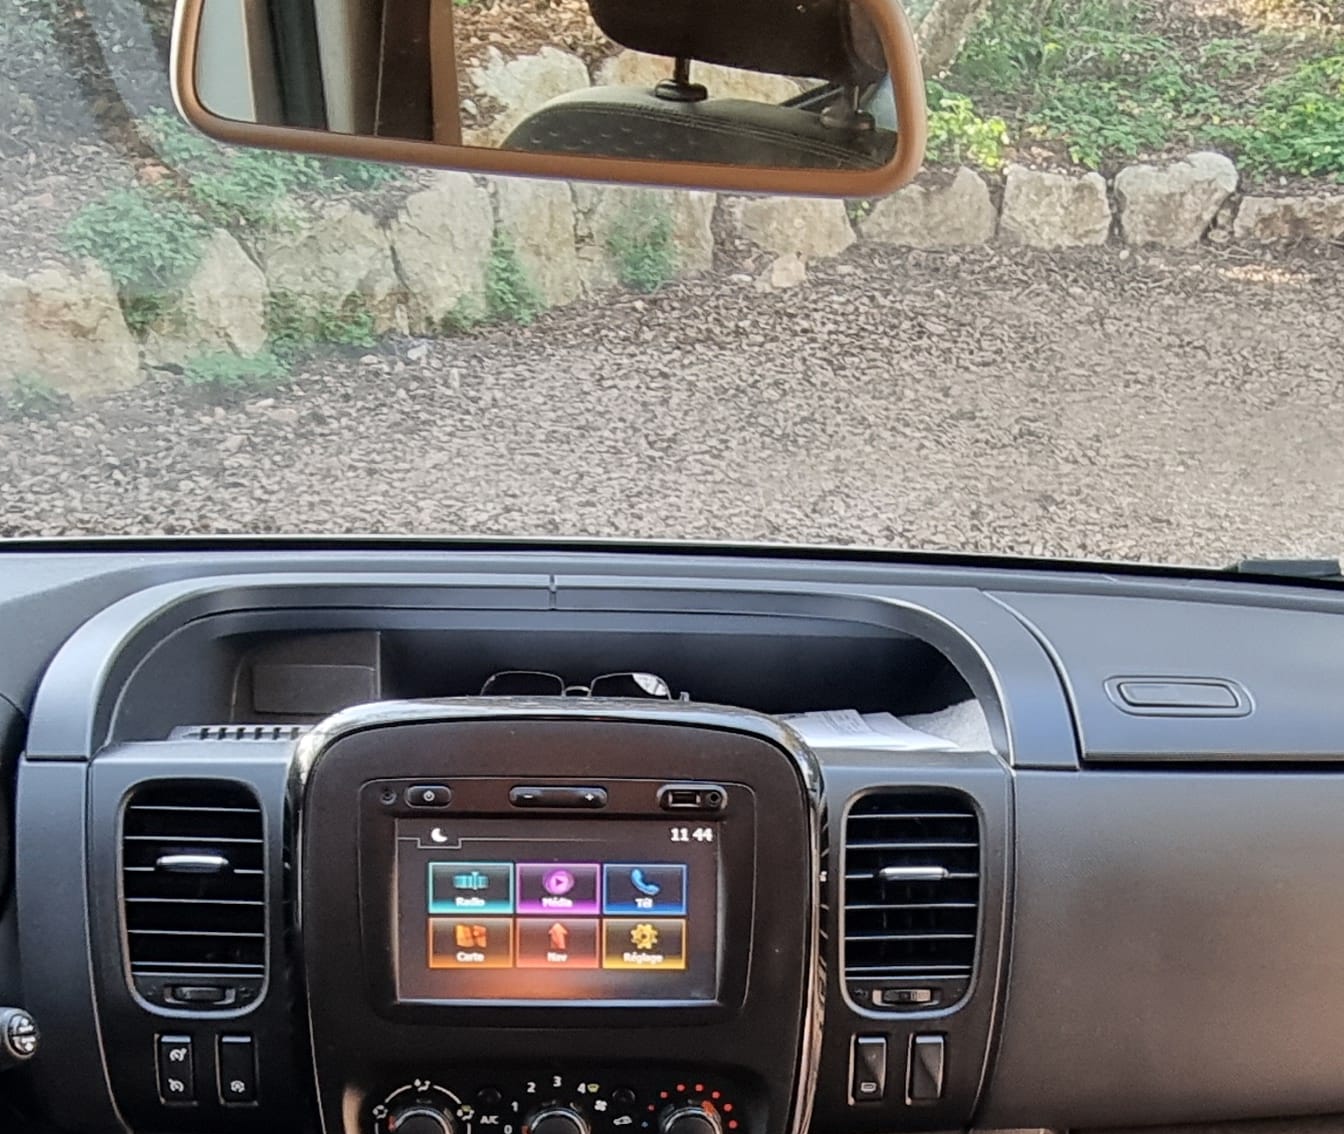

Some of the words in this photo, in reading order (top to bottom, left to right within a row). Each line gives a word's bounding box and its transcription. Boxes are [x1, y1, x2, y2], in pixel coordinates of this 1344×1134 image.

[511, 1101, 519, 1112] 1
[527, 1082, 536, 1093] 2
[553, 1075, 562, 1087] 3
[577, 1082, 586, 1094] 4
[479, 1115, 499, 1125] A/C
